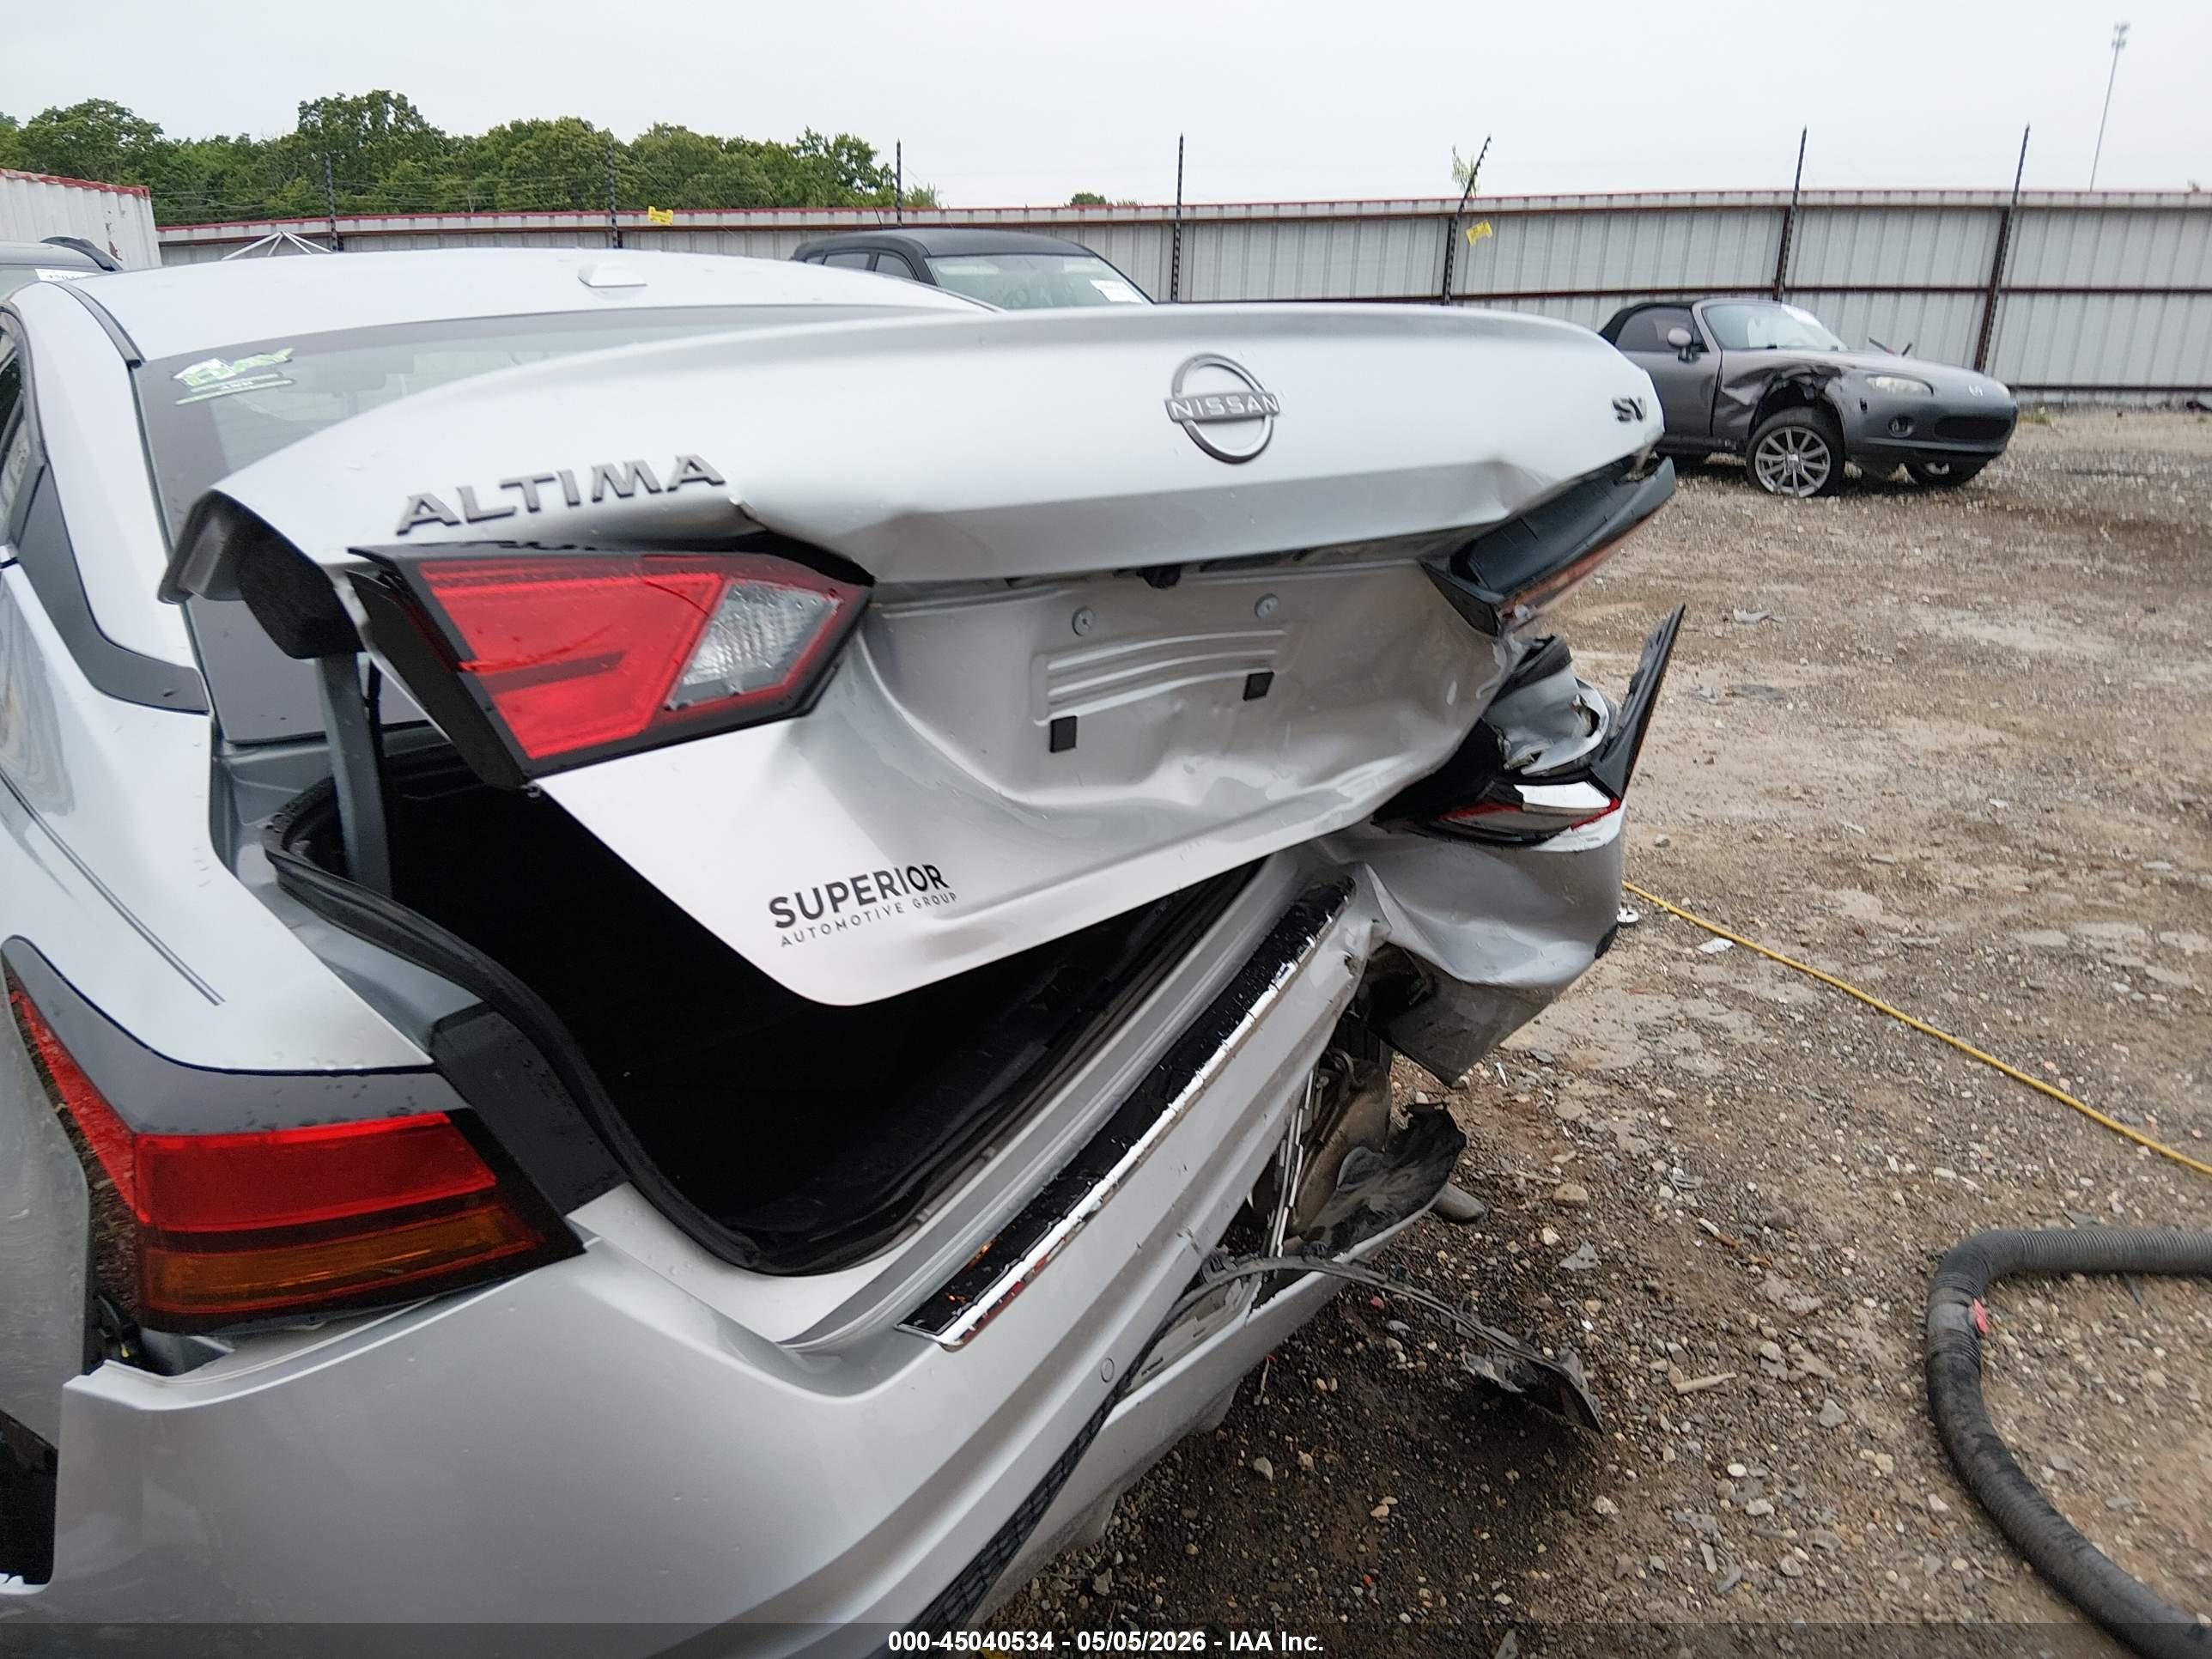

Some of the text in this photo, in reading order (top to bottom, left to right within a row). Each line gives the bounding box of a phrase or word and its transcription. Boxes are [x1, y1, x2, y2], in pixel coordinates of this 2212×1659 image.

[1169, 392, 1279, 419] NISSAN
[1612, 397, 1647, 422] SV
[396, 453, 725, 536] ALTIMA
[769, 864, 950, 929] SUPERIOR
[780, 891, 957, 947] AUTOMOTIVE GROUP
